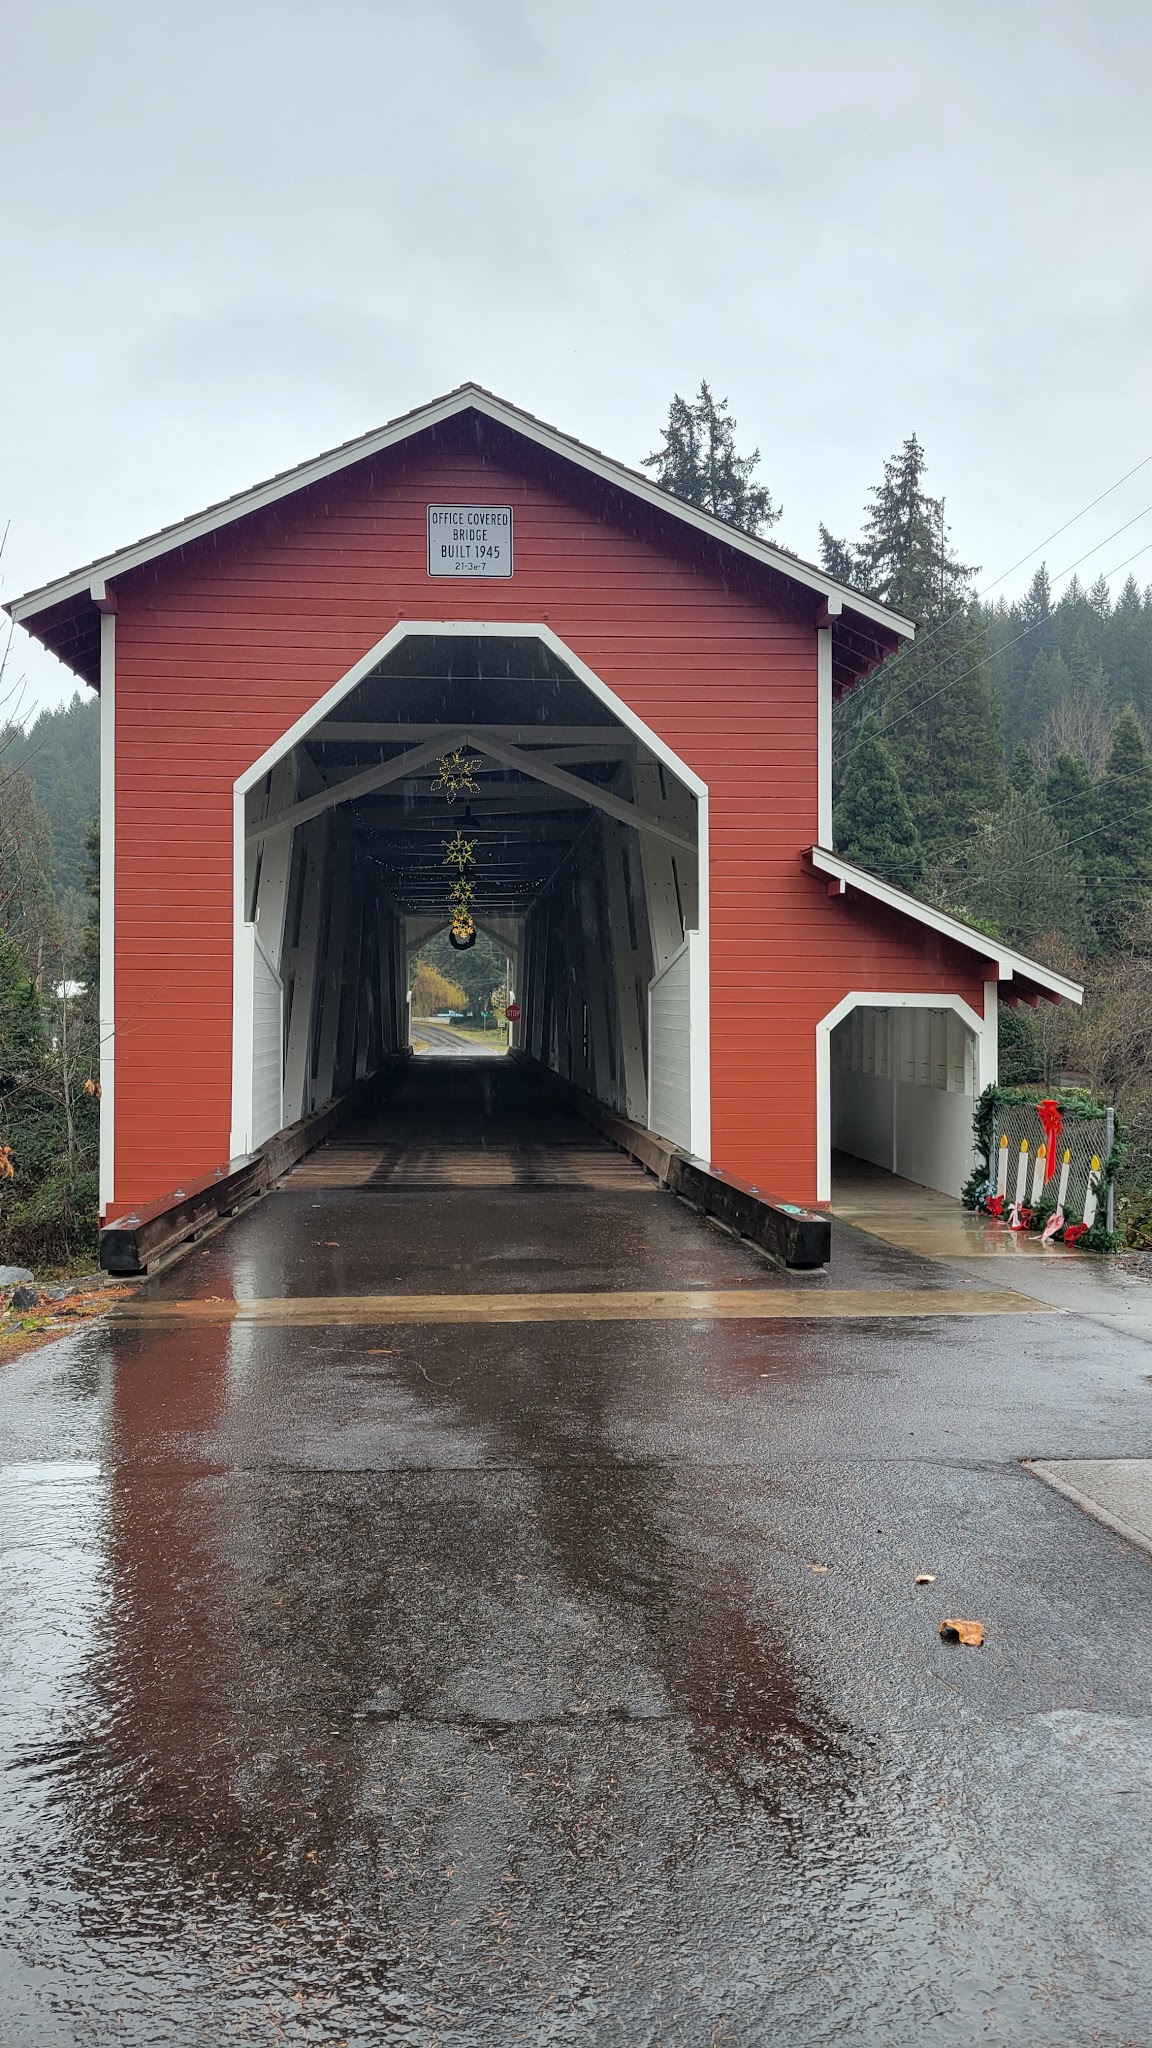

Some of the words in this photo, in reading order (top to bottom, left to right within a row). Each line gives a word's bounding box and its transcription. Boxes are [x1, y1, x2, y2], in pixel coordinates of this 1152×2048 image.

[432, 512, 464, 525] OFFICE
[467, 513, 508, 526] COVERED
[453, 528, 488, 541] BRIDGE
[441, 545, 471, 558] BUILT
[475, 545, 500, 559] 1945
[455, 562, 487, 571] 21-3e-7
